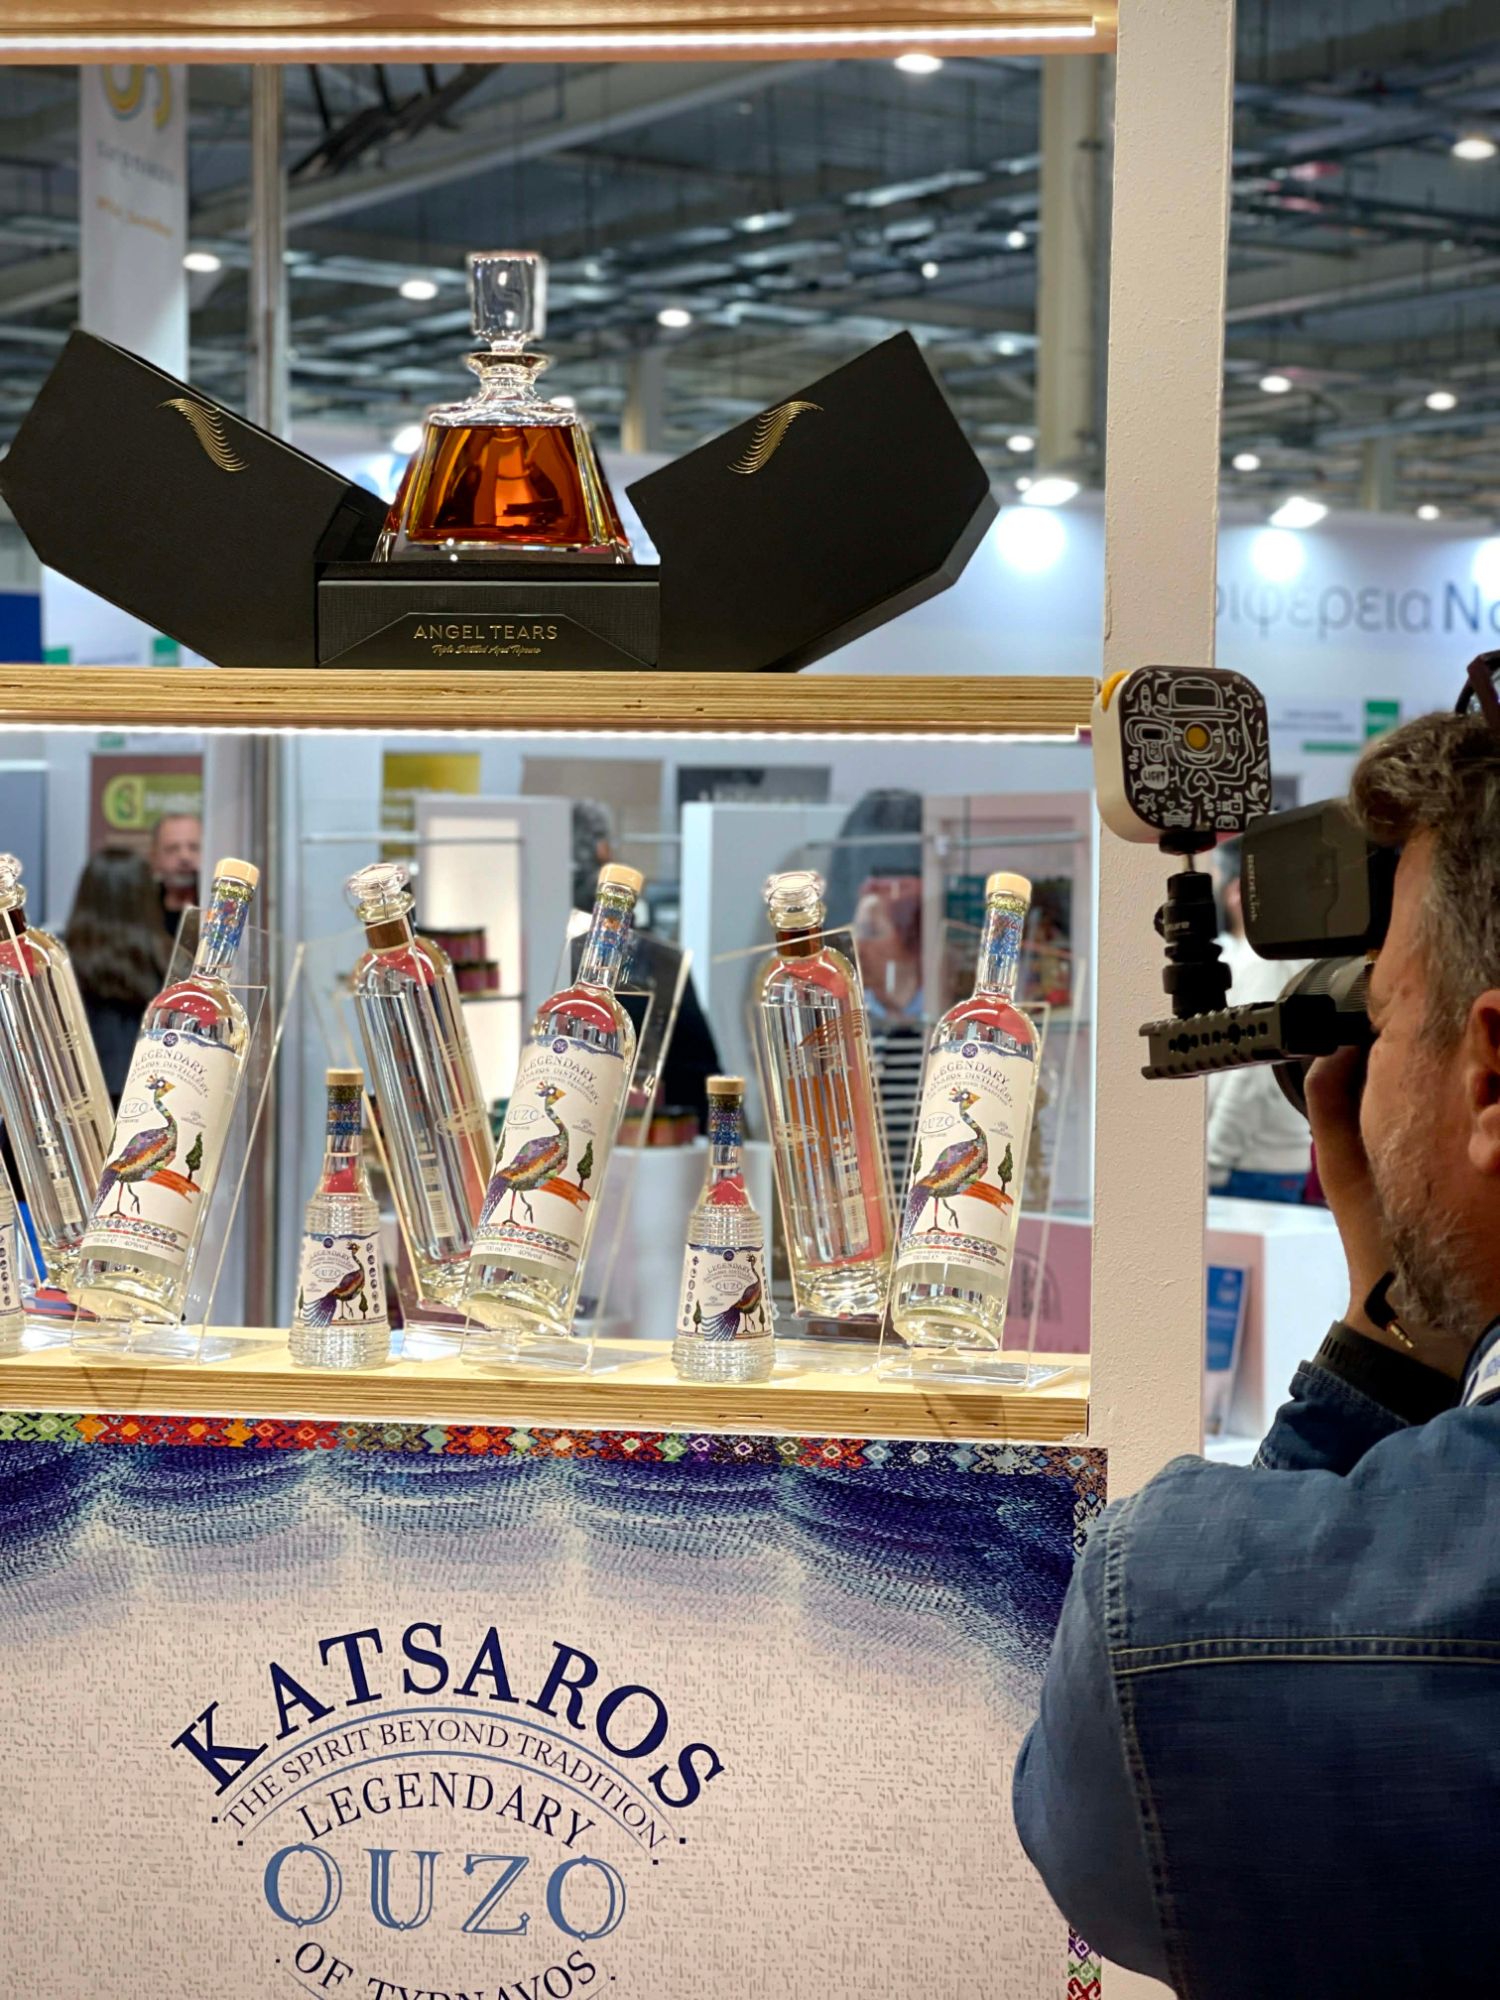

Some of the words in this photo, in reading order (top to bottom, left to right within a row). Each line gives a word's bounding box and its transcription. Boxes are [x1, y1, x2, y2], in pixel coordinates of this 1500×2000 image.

[414, 625, 485, 639] ANGEL
[490, 625, 558, 640] TEARS
[135, 1048, 207, 1075] LEGENDARY
[523, 1055, 598, 1082] LEGENDARY
[933, 1060, 1010, 1084] LEGENDARY
[171, 1622, 725, 1809] KATSAROS
[223, 1775, 283, 1829] THE
[282, 1727, 370, 1783] SPIRIT
[378, 1719, 509, 1749] BEYOND
[517, 1732, 668, 1849] TRADITION
[296, 1771, 596, 1849] LEGENDARY
[264, 1842, 626, 1941] OUZO
[294, 1942, 354, 1989] OF
